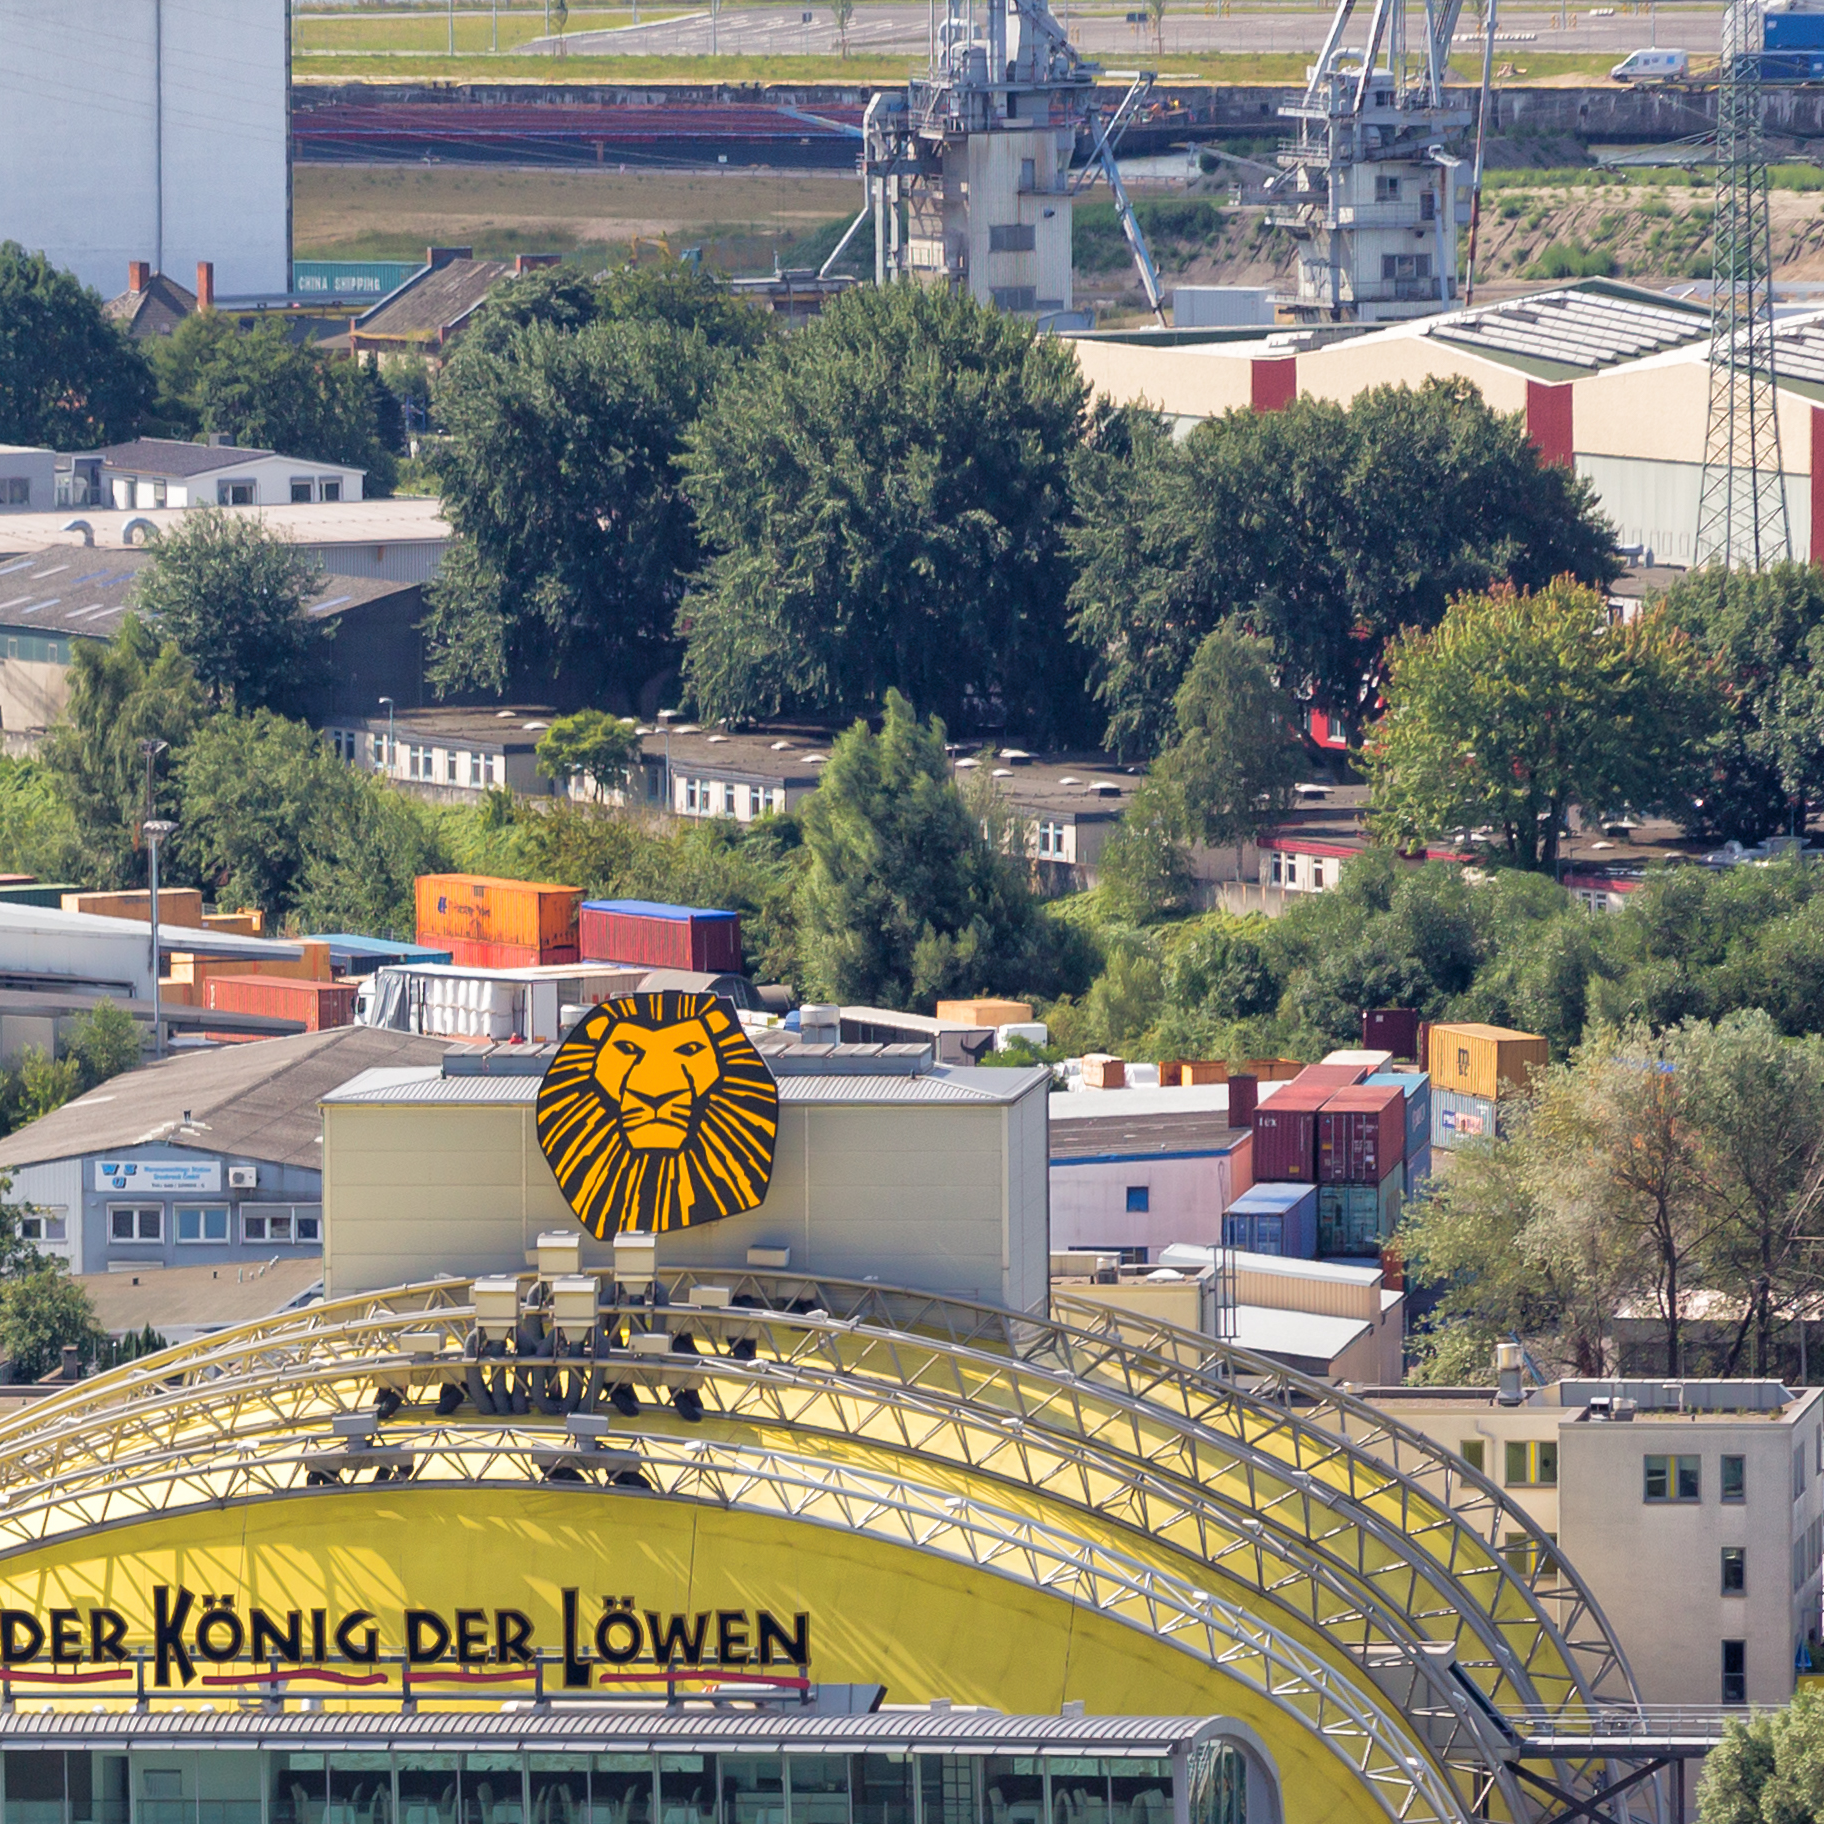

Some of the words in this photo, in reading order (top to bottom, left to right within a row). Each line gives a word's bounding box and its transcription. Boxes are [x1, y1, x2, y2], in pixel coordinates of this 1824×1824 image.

[298, 275, 329, 291] CHINA
[334, 276, 381, 292] SHIPPING
[152, 1584, 380, 1687] KÖNIG
[405, 1608, 536, 1664] DER
[561, 1586, 811, 1688] LÖWEN
